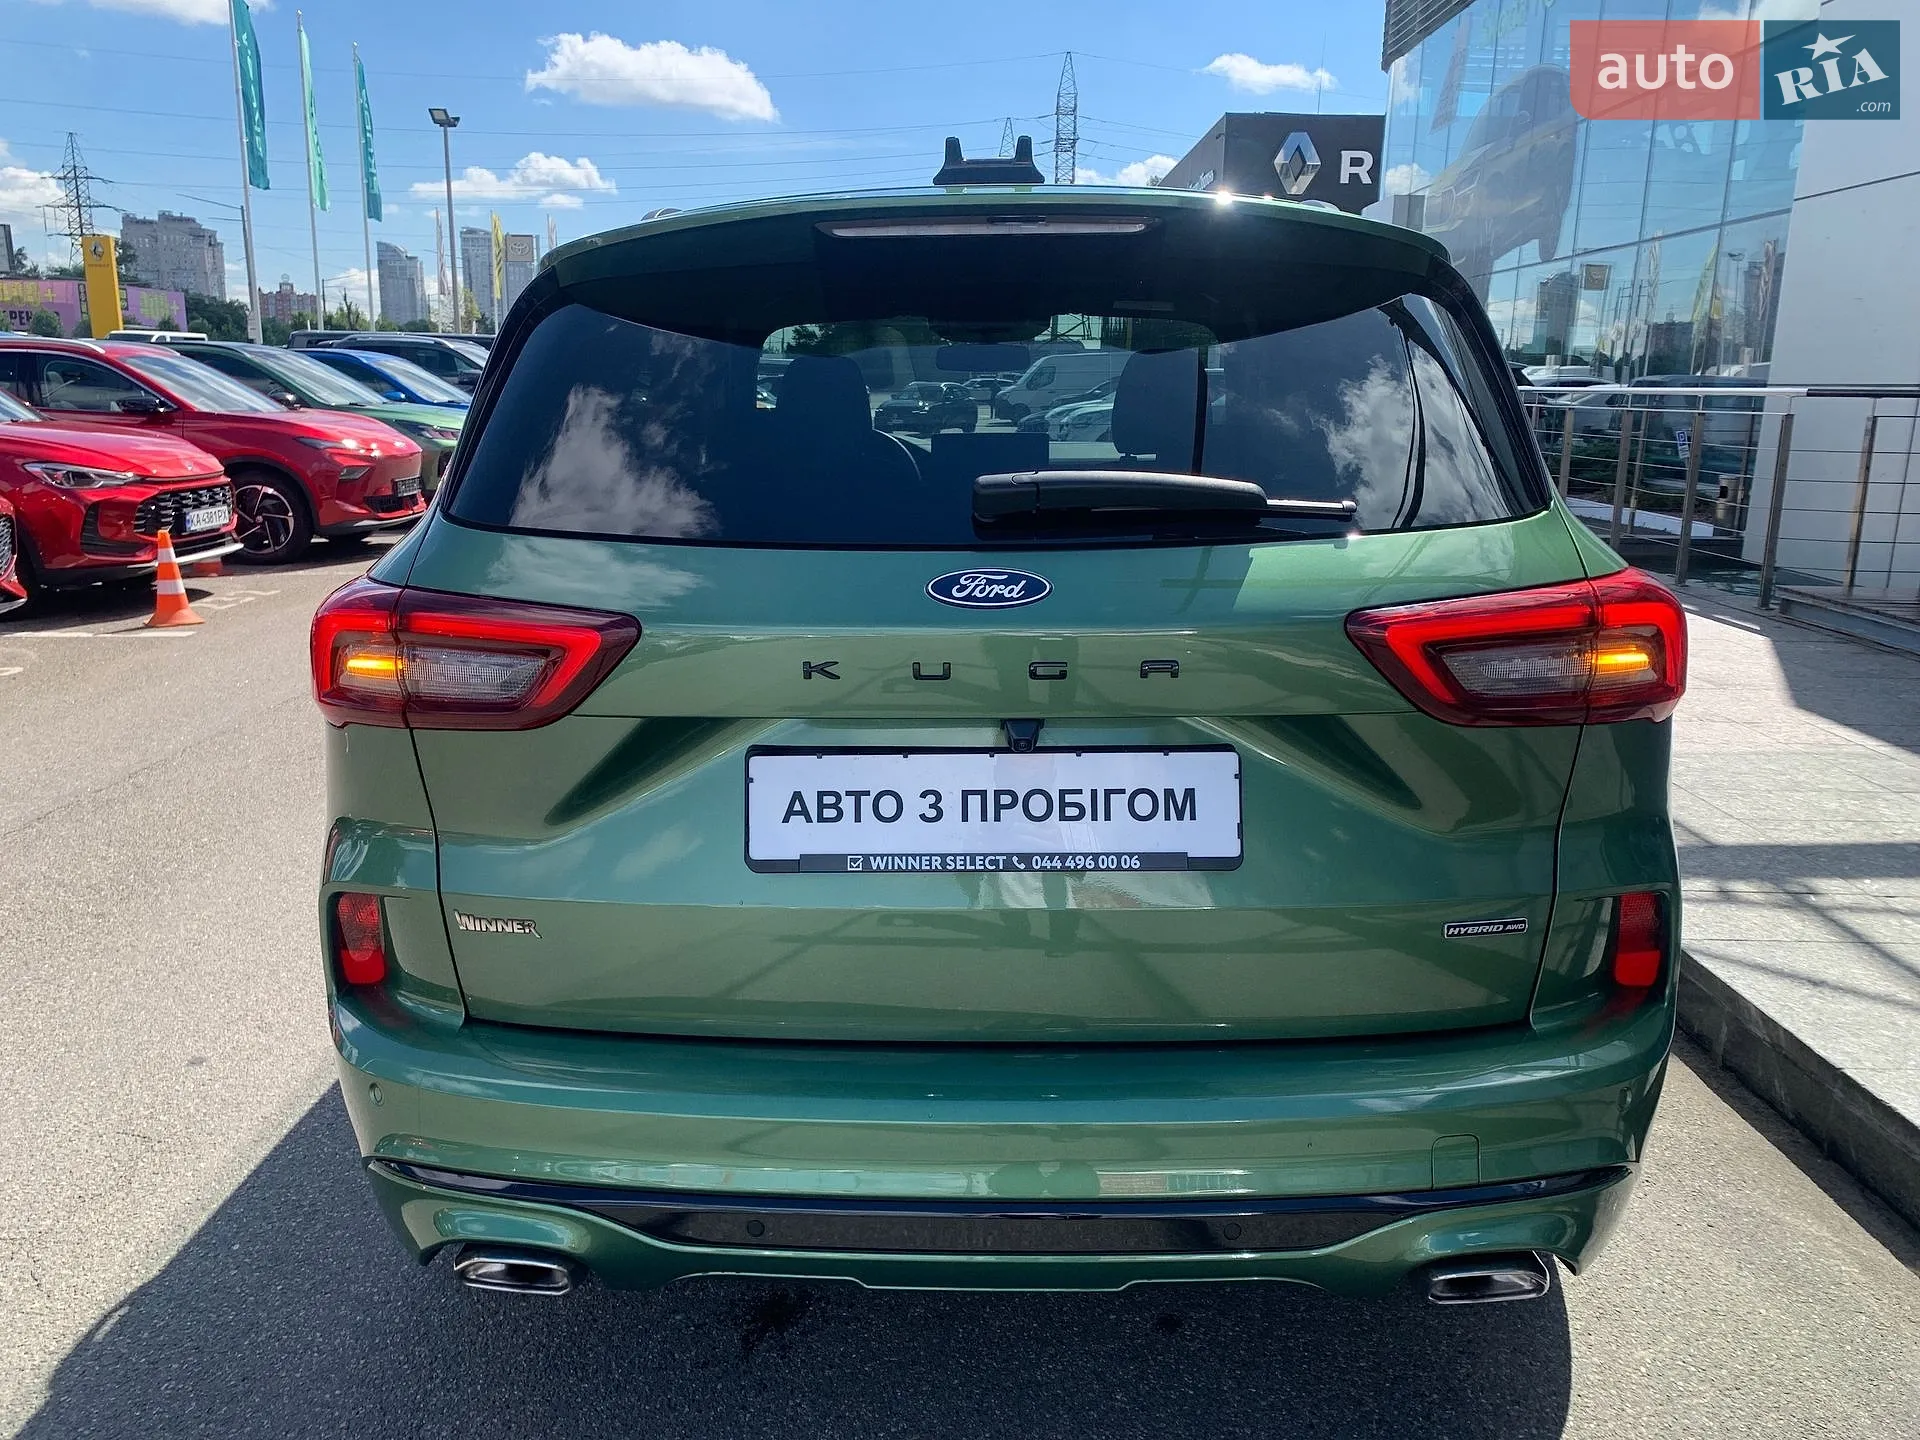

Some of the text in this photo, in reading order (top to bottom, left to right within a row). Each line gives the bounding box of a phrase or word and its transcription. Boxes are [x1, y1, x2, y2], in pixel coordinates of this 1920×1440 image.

[951, 572, 1025, 599] Ford
[802, 660, 1180, 681] KUGA
[781, 789, 904, 824] АВТО
[960, 787, 1197, 823] ПРОБІГОМ
[869, 855, 1141, 870] WINNER SELECT 044 496 00 06
[453, 909, 542, 939] WINNER
[1448, 923, 1525, 935] HYBRID AWD
